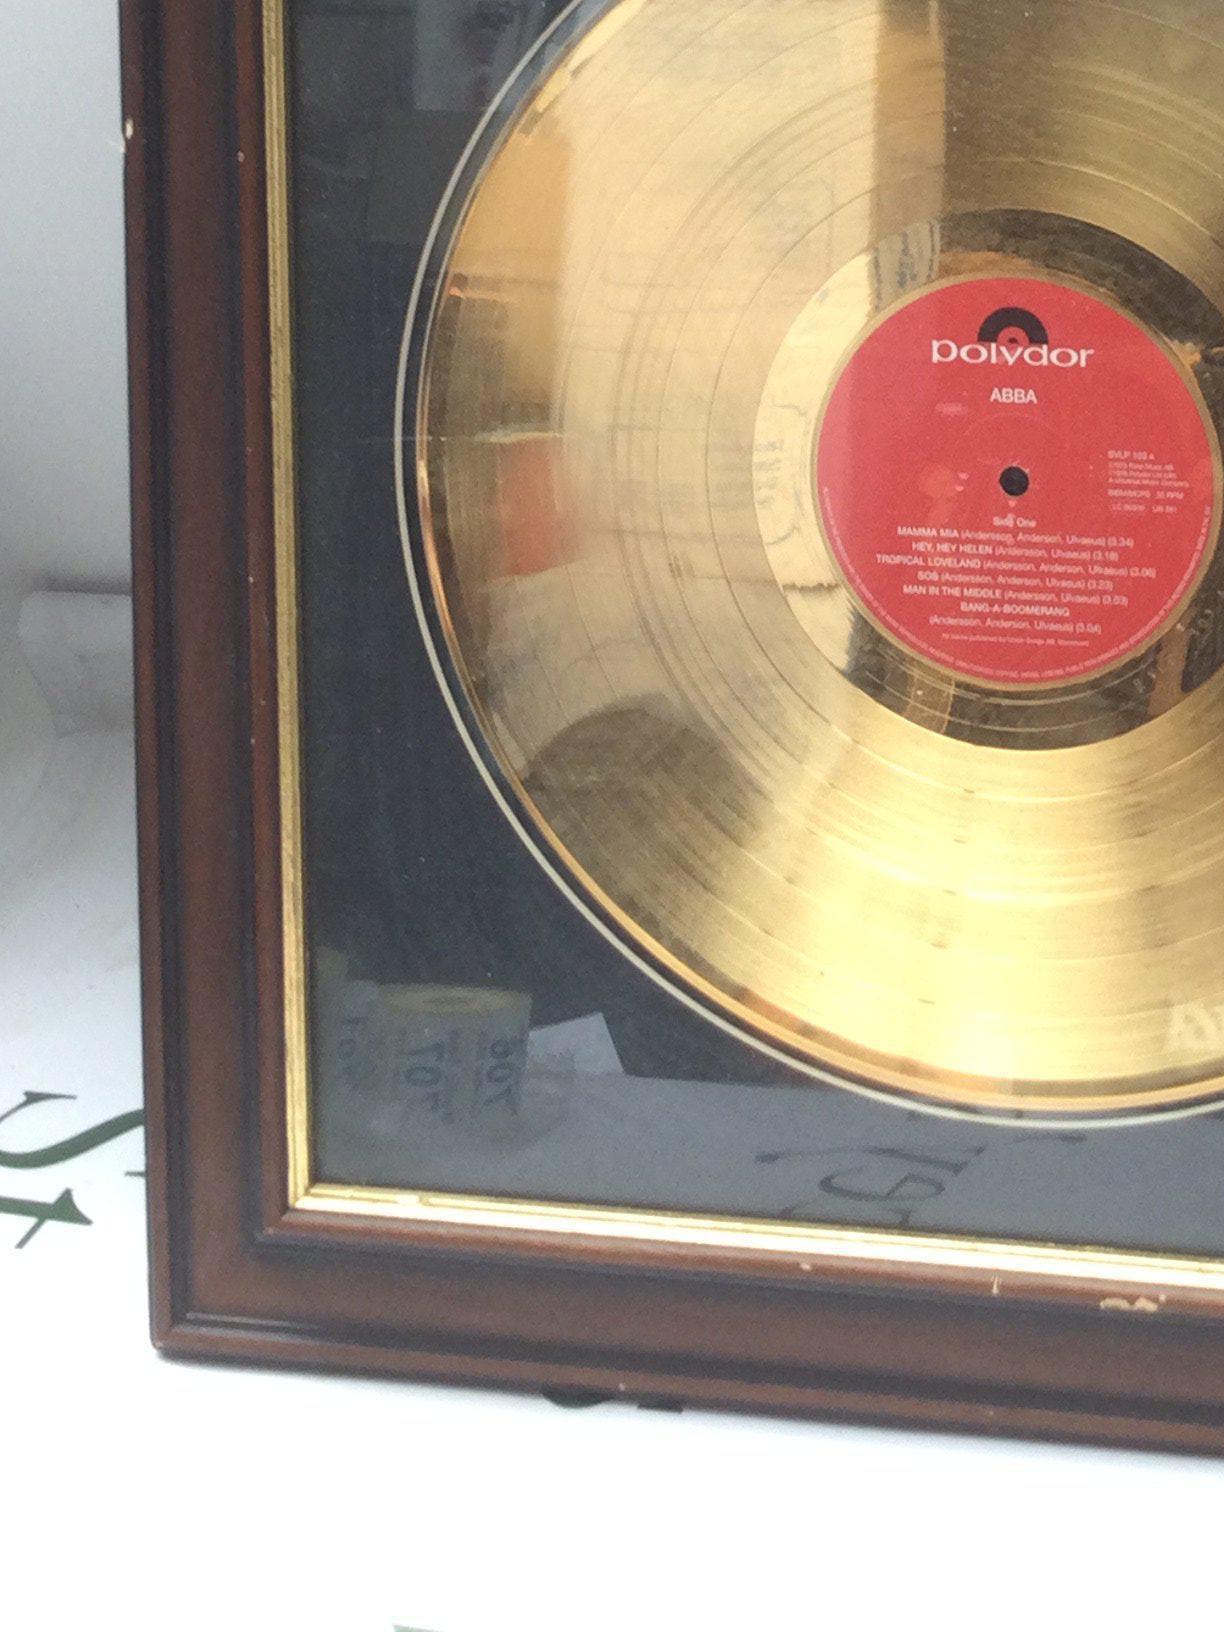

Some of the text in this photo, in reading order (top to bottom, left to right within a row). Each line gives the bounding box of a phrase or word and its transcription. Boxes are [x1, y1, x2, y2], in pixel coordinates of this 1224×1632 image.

[931, 338, 1095, 368] polydor
[990, 387, 1037, 404] ABBA
[1016, 517, 1037, 528] One
[897, 526, 938, 538] MAMMA
[939, 527, 960, 539] MIA
[936, 542, 957, 553] HEY
[959, 543, 993, 555] HELEN
[876, 554, 926, 566] TROPICAL
[927, 557, 981, 569] LOVELAND
[917, 570, 939, 581] SOS
[903, 584, 1001, 599] MAN IN THE MIDDLE
